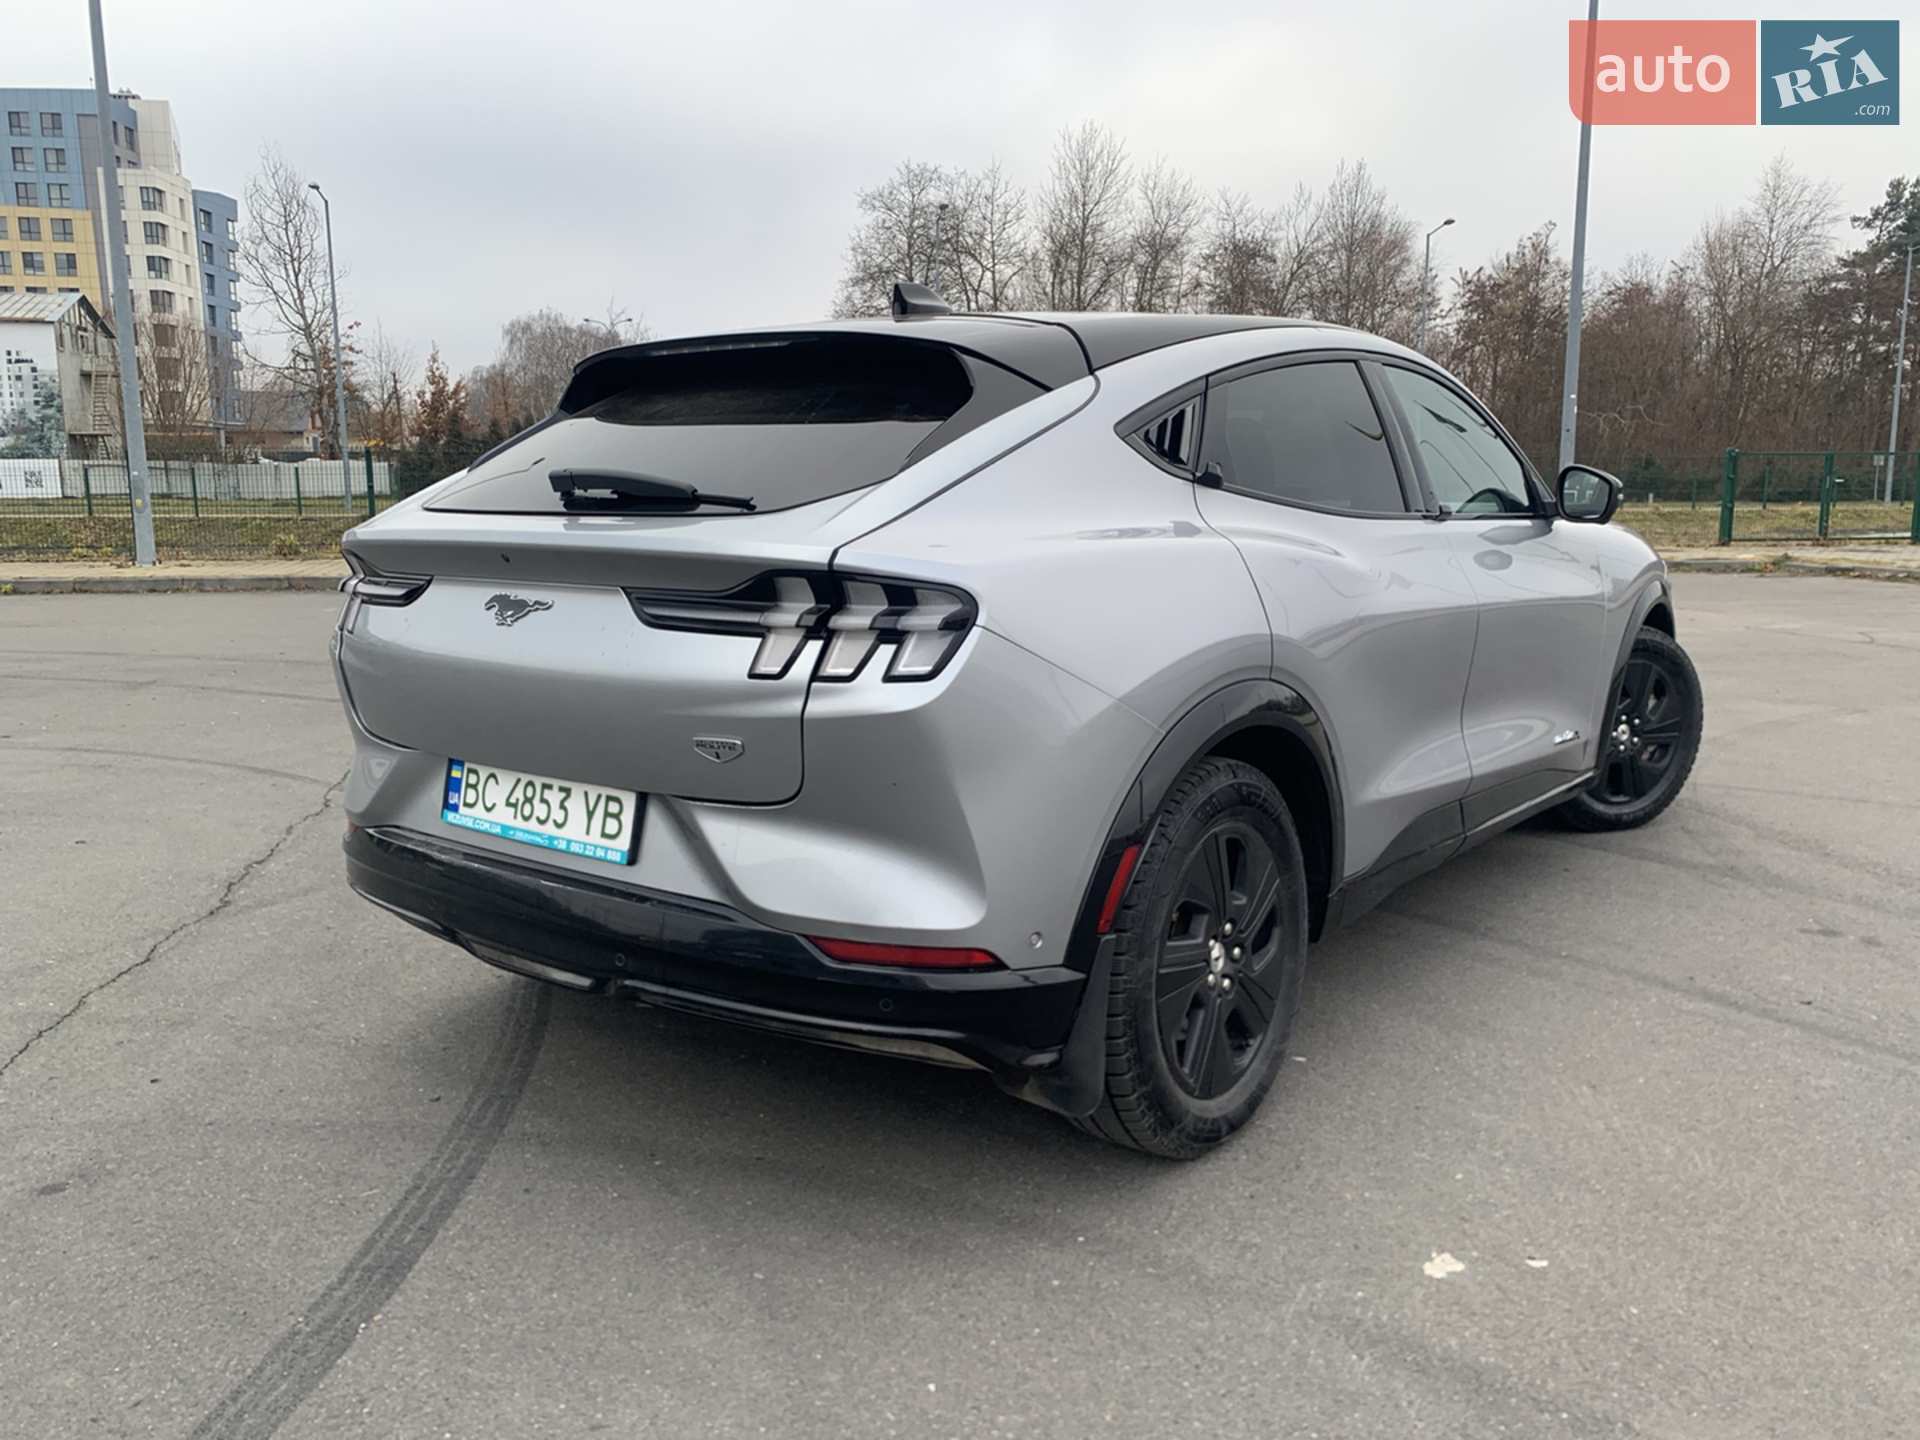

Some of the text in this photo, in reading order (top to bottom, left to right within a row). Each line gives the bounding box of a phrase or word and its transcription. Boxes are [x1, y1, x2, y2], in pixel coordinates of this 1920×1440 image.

[448, 791, 460, 805] UA
[462, 767, 624, 840] BC 4853 YB
